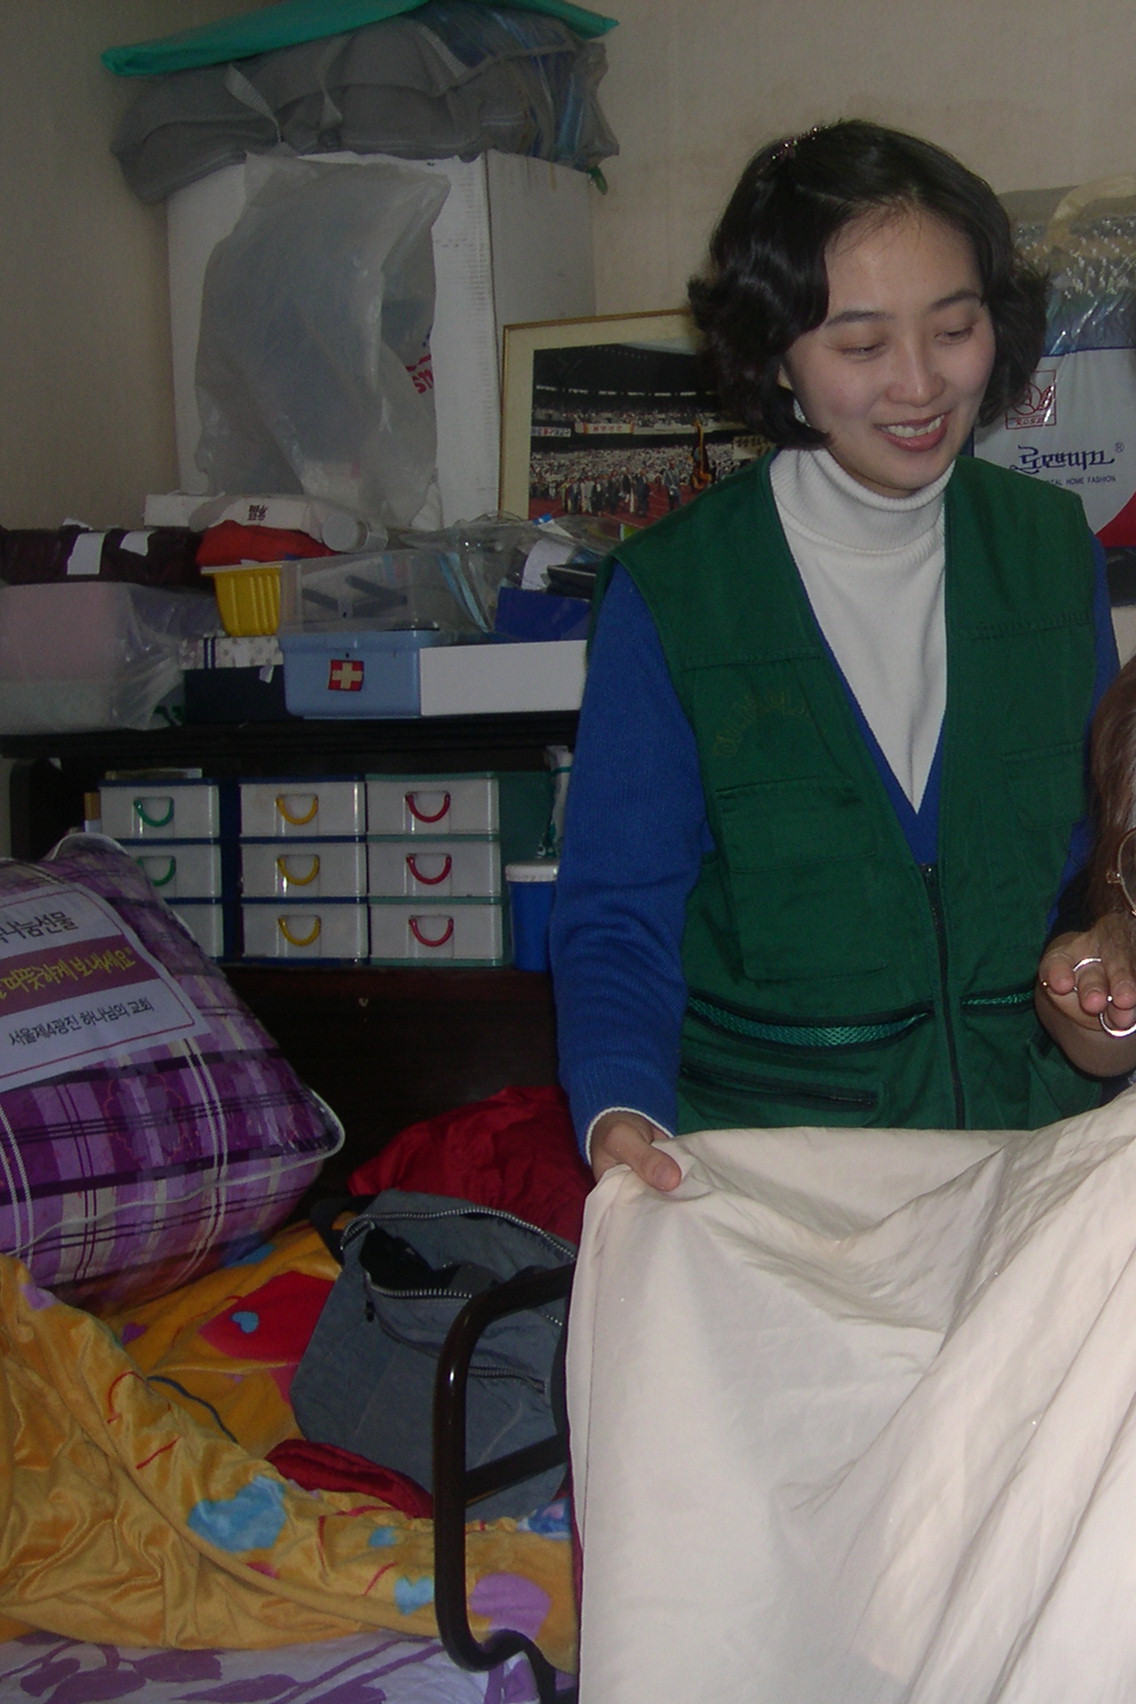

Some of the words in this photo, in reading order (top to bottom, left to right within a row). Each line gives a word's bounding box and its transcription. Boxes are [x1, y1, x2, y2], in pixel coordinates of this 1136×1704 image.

[1066, 476, 1085, 485] HOME
[1087, 474, 1116, 484] FASHION
[81, 1002, 130, 1026] 하나님의
[127, 996, 155, 1015] 교회
